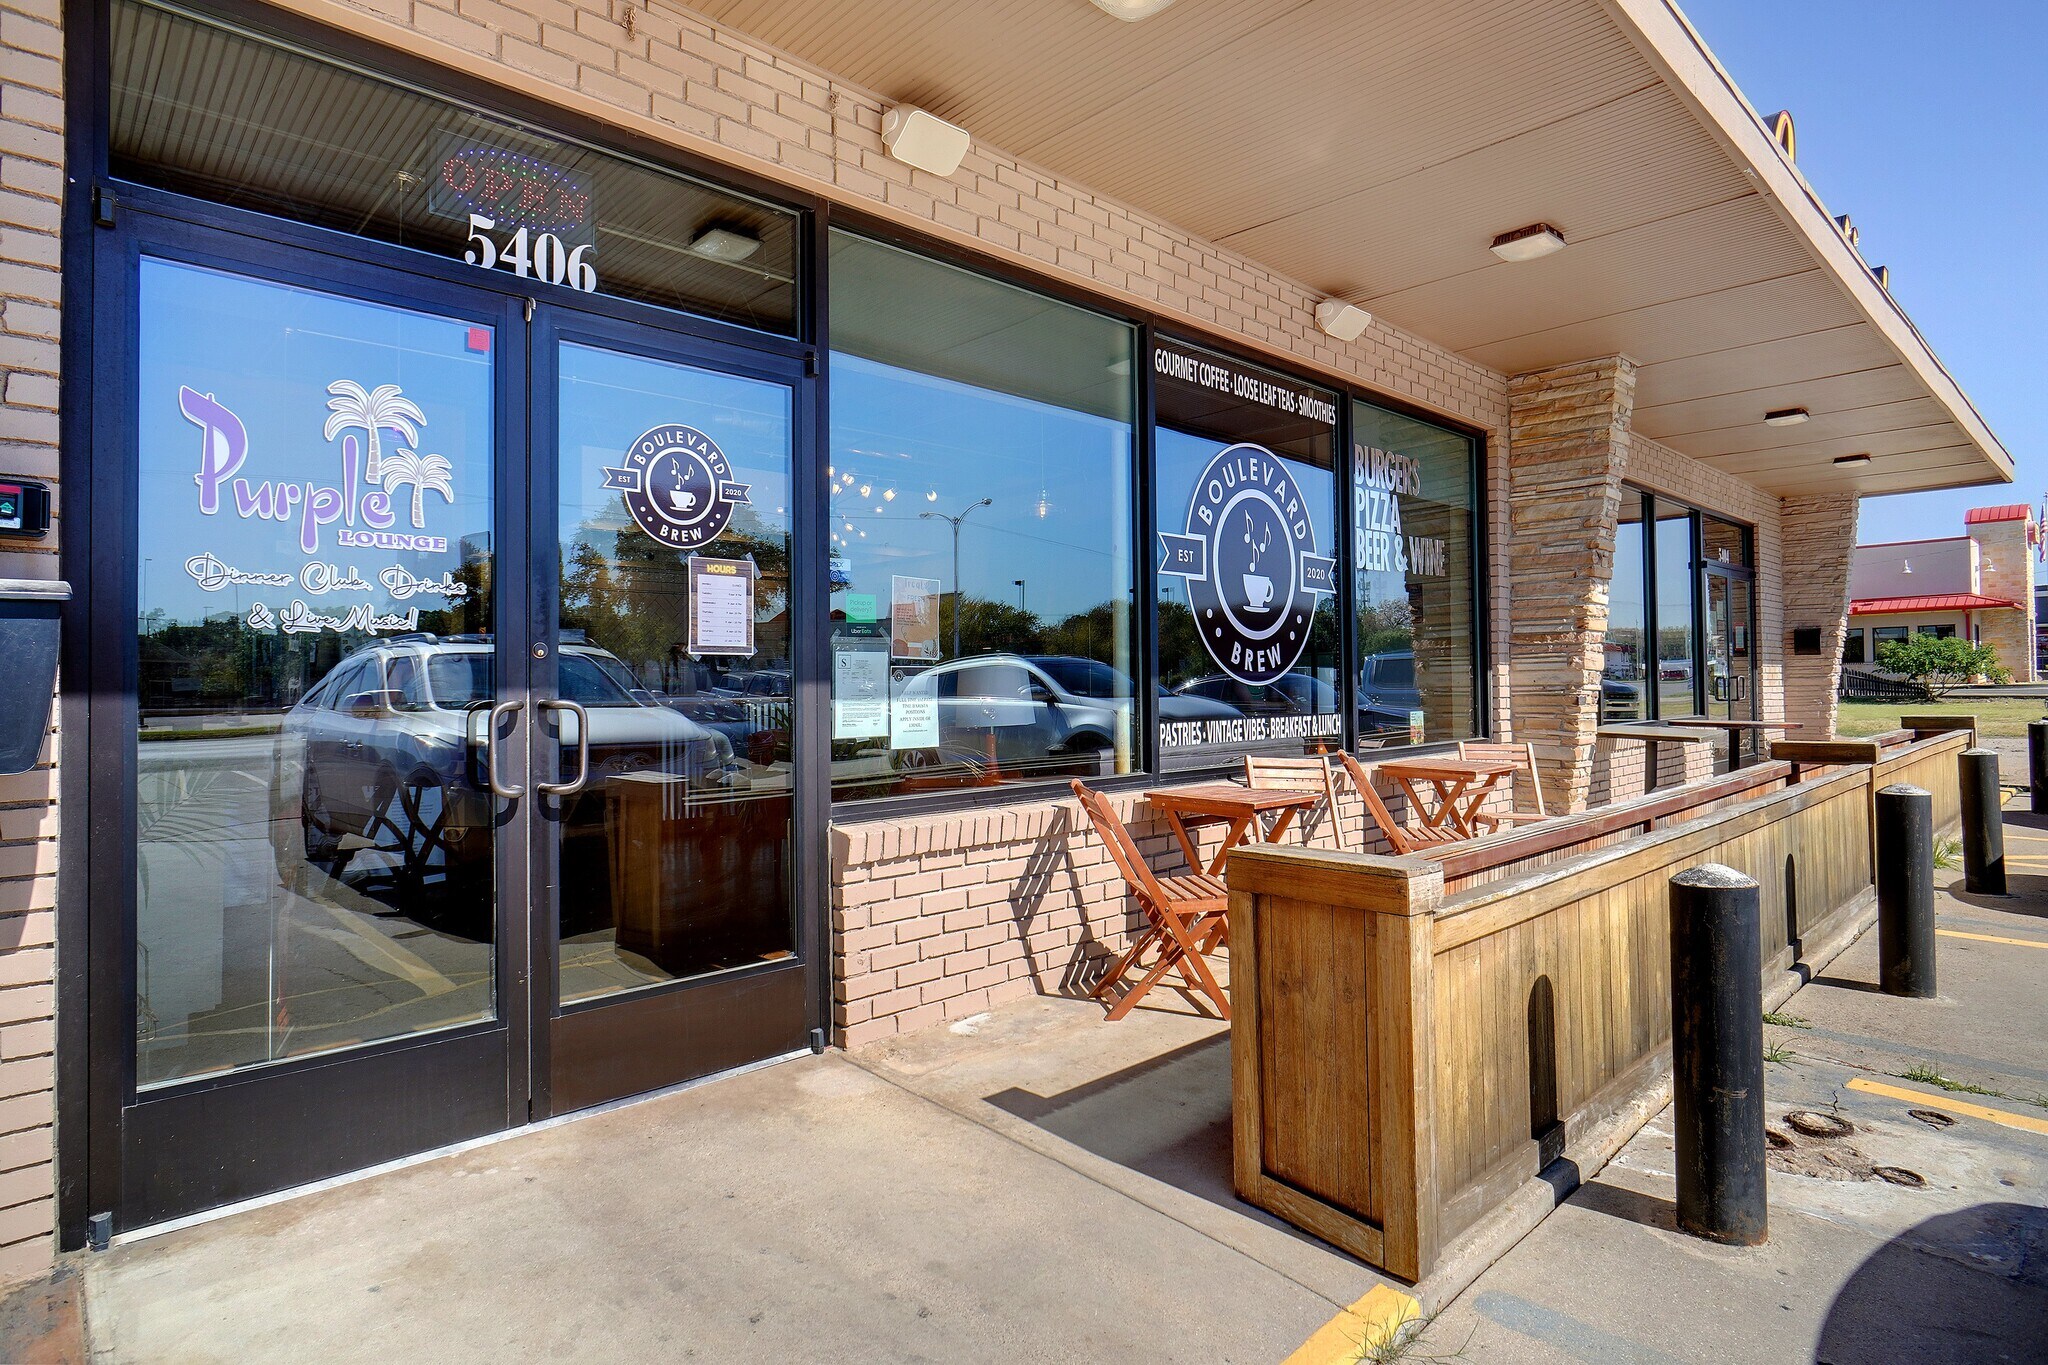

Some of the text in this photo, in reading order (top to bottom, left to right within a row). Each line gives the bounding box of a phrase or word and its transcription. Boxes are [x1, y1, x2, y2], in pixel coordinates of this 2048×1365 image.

[443, 159, 589, 223] OPEN
[464, 213, 597, 293] 5406
[1154, 348, 1336, 425] GOURMET COFFEE LOOSE LEAF TEAS SMOOTHIES
[179, 385, 396, 553] Purple
[633, 431, 725, 475] BOULEVARD
[1354, 443, 1421, 497] BURGERS
[618, 475, 631, 483] EST
[724, 488, 742, 497] 2020
[1197, 457, 1307, 540] BOULEVARD
[1355, 486, 1402, 534] PIZZA
[338, 530, 447, 552] LOUNGE
[659, 524, 703, 542] BREW
[706, 563, 737, 574] HOURS
[1178, 548, 1194, 563] EST
[1355, 527, 1446, 577] BEER & WINE
[185, 552, 294, 591] Dinner
[379, 564, 467, 599] Drinks
[1306, 566, 1326, 580] 2020
[247, 599, 419, 635] & Live Music!
[850, 606, 873, 614] delivery?
[1230, 641, 1281, 672] BREW
[1159, 714, 1342, 748] PASTRIES VINTAGE VIBES BREAKFAST & LUNCH
